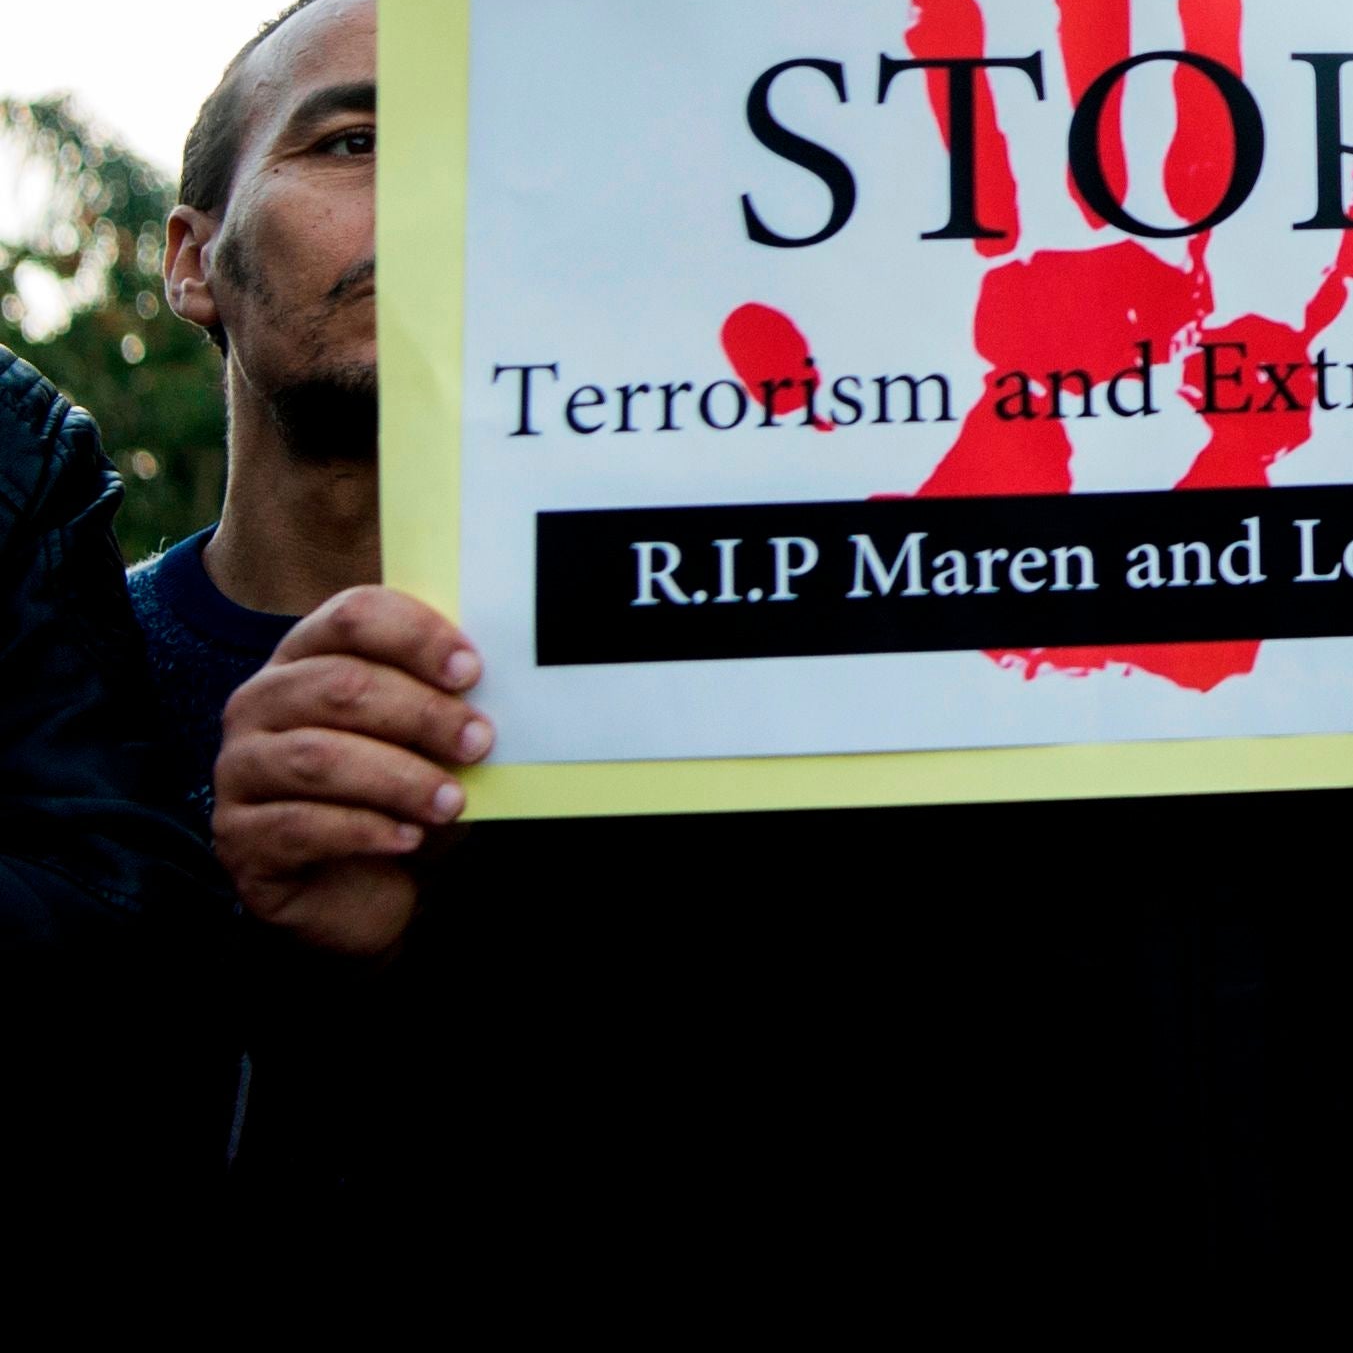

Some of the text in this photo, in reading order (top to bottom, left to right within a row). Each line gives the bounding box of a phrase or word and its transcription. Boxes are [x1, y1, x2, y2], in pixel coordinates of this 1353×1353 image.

[493, 357, 955, 437] Terrorism
[994, 341, 1159, 421] and
[633, 538, 818, 605] R.I.P
[846, 532, 1098, 597] Maren
[1126, 515, 1267, 587] and
